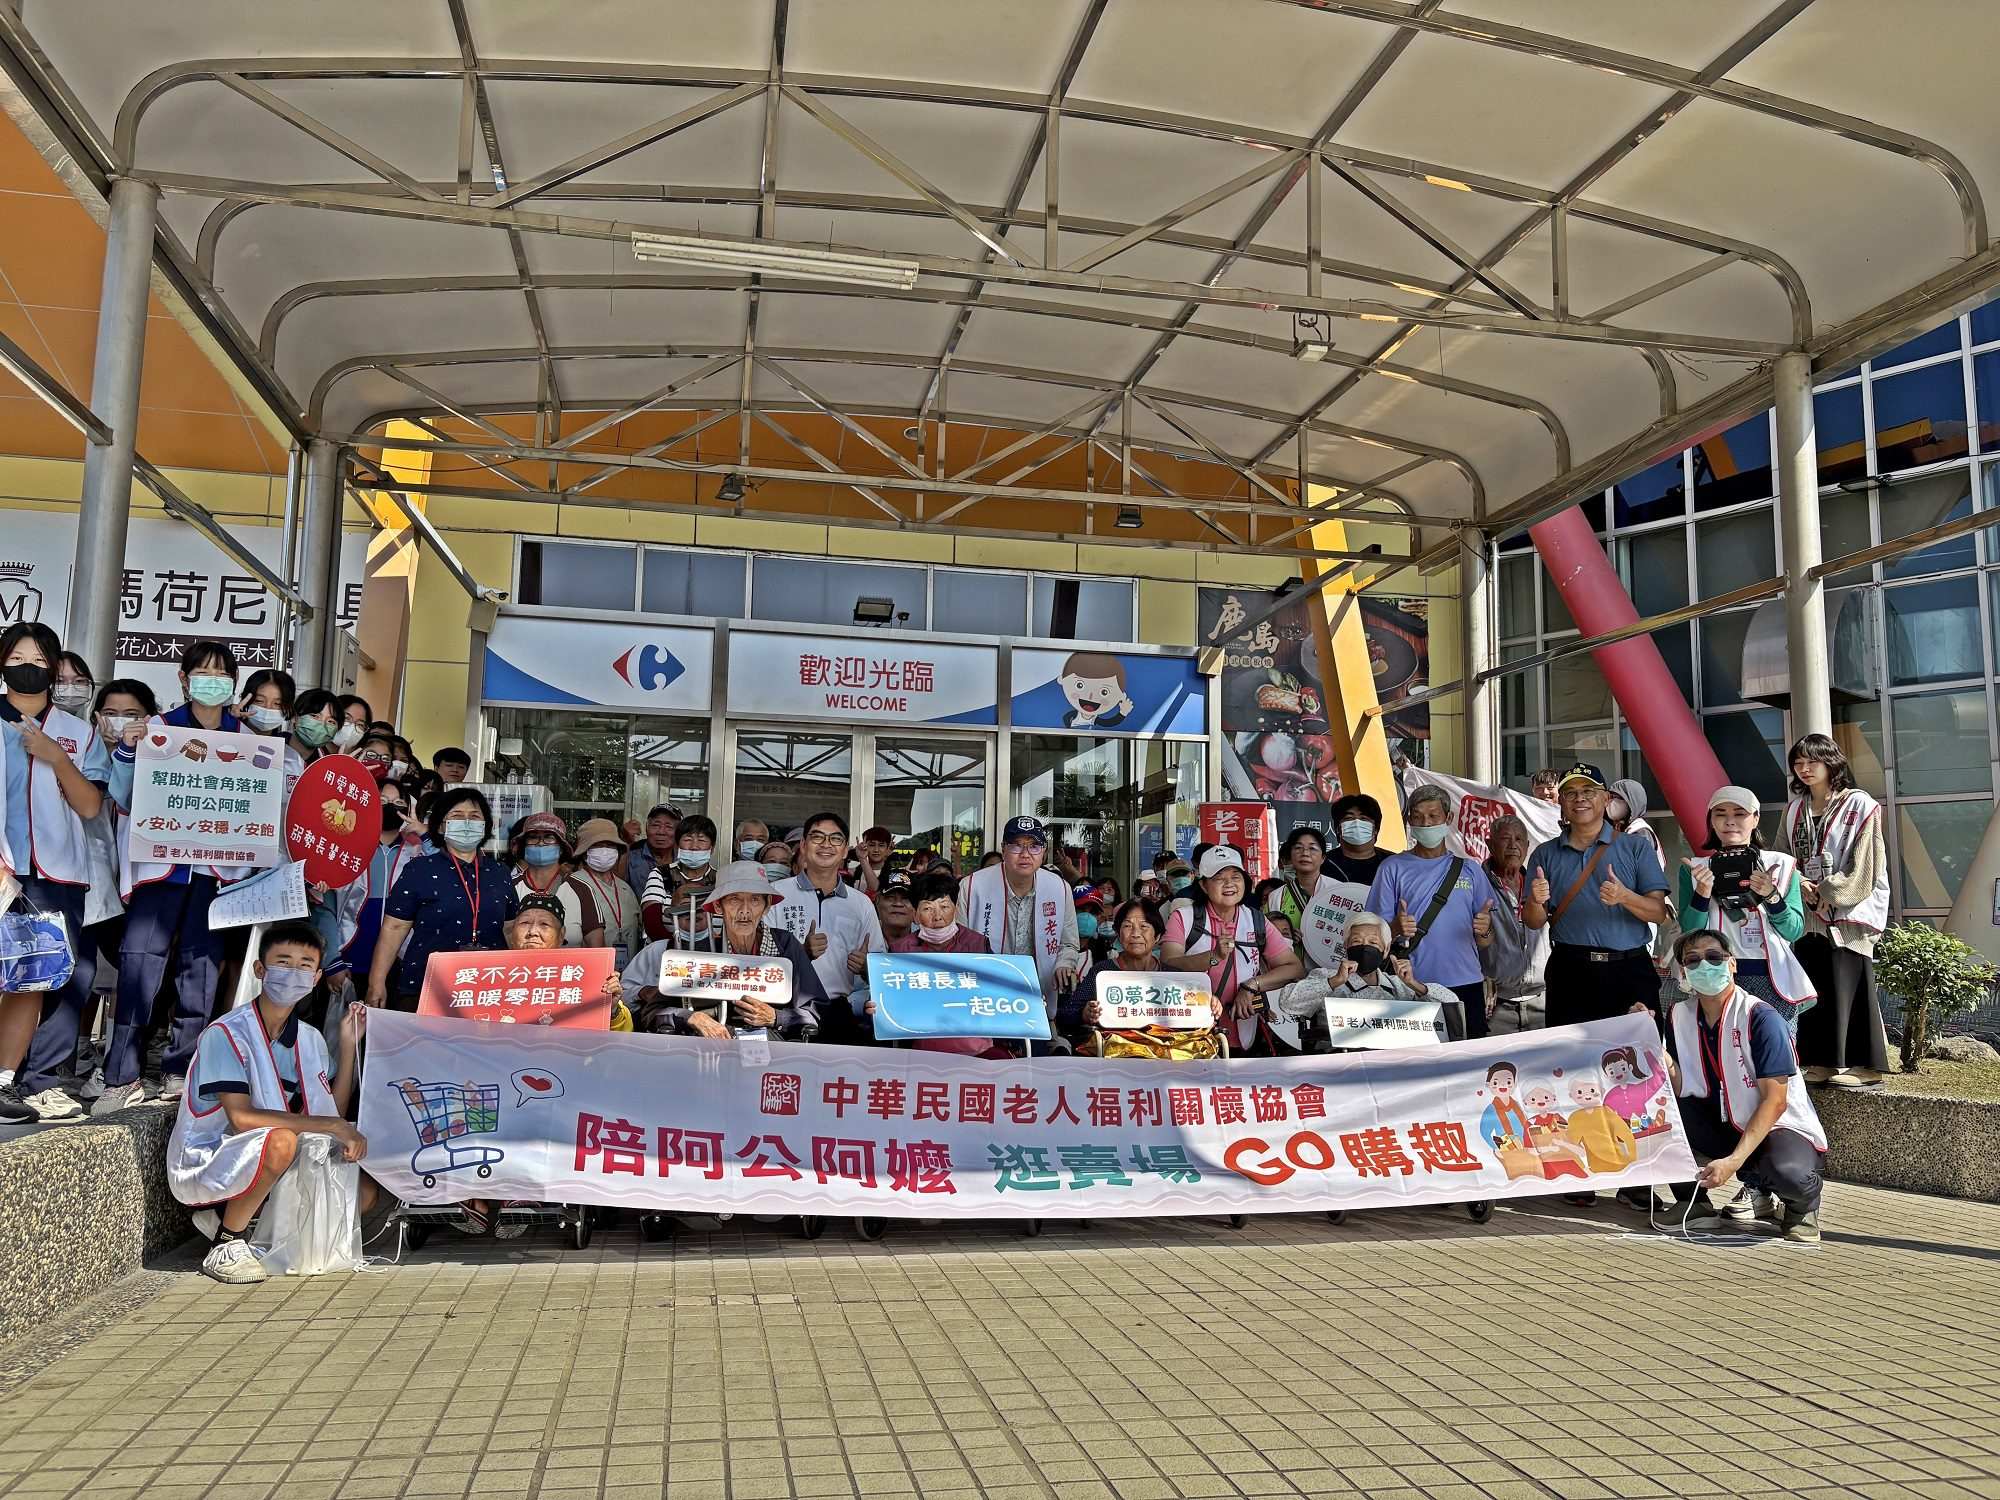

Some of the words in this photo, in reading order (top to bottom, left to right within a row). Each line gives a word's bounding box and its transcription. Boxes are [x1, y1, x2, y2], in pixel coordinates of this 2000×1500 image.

[799, 654, 935, 692] 歡迎光臨
[826, 694, 907, 712] WELCOME
[151, 770, 268, 794] 幫助社會角落裡
[323, 769, 371, 807] 用愛點亮
[167, 794, 250, 814] 的阿公阿嬤
[149, 816, 181, 831] 安心
[198, 819, 229, 834] 安穩
[245, 822, 275, 837] 安飽
[170, 848, 256, 861] 老人福利關懷協會
[290, 824, 362, 872] 弱勢長輩生活
[454, 965, 585, 985] 愛不分年齡
[698, 963, 784, 983] 青銀共遊
[882, 972, 979, 990] 守護長輩
[449, 987, 583, 1008] 溫暖零距離
[1106, 986, 1181, 1005] 圓夢之旅
[943, 996, 1030, 1016] 一起GO
[1347, 1016, 1445, 1033] 老人福利關懷協會
[822, 1076, 1327, 1127] 中華民國老人福利關懷協會
[573, 1111, 957, 1196] 陪阿公阿嬤
[985, 1141, 1203, 1194] 逛賣場
[1224, 1121, 1485, 1187] GO購趣
